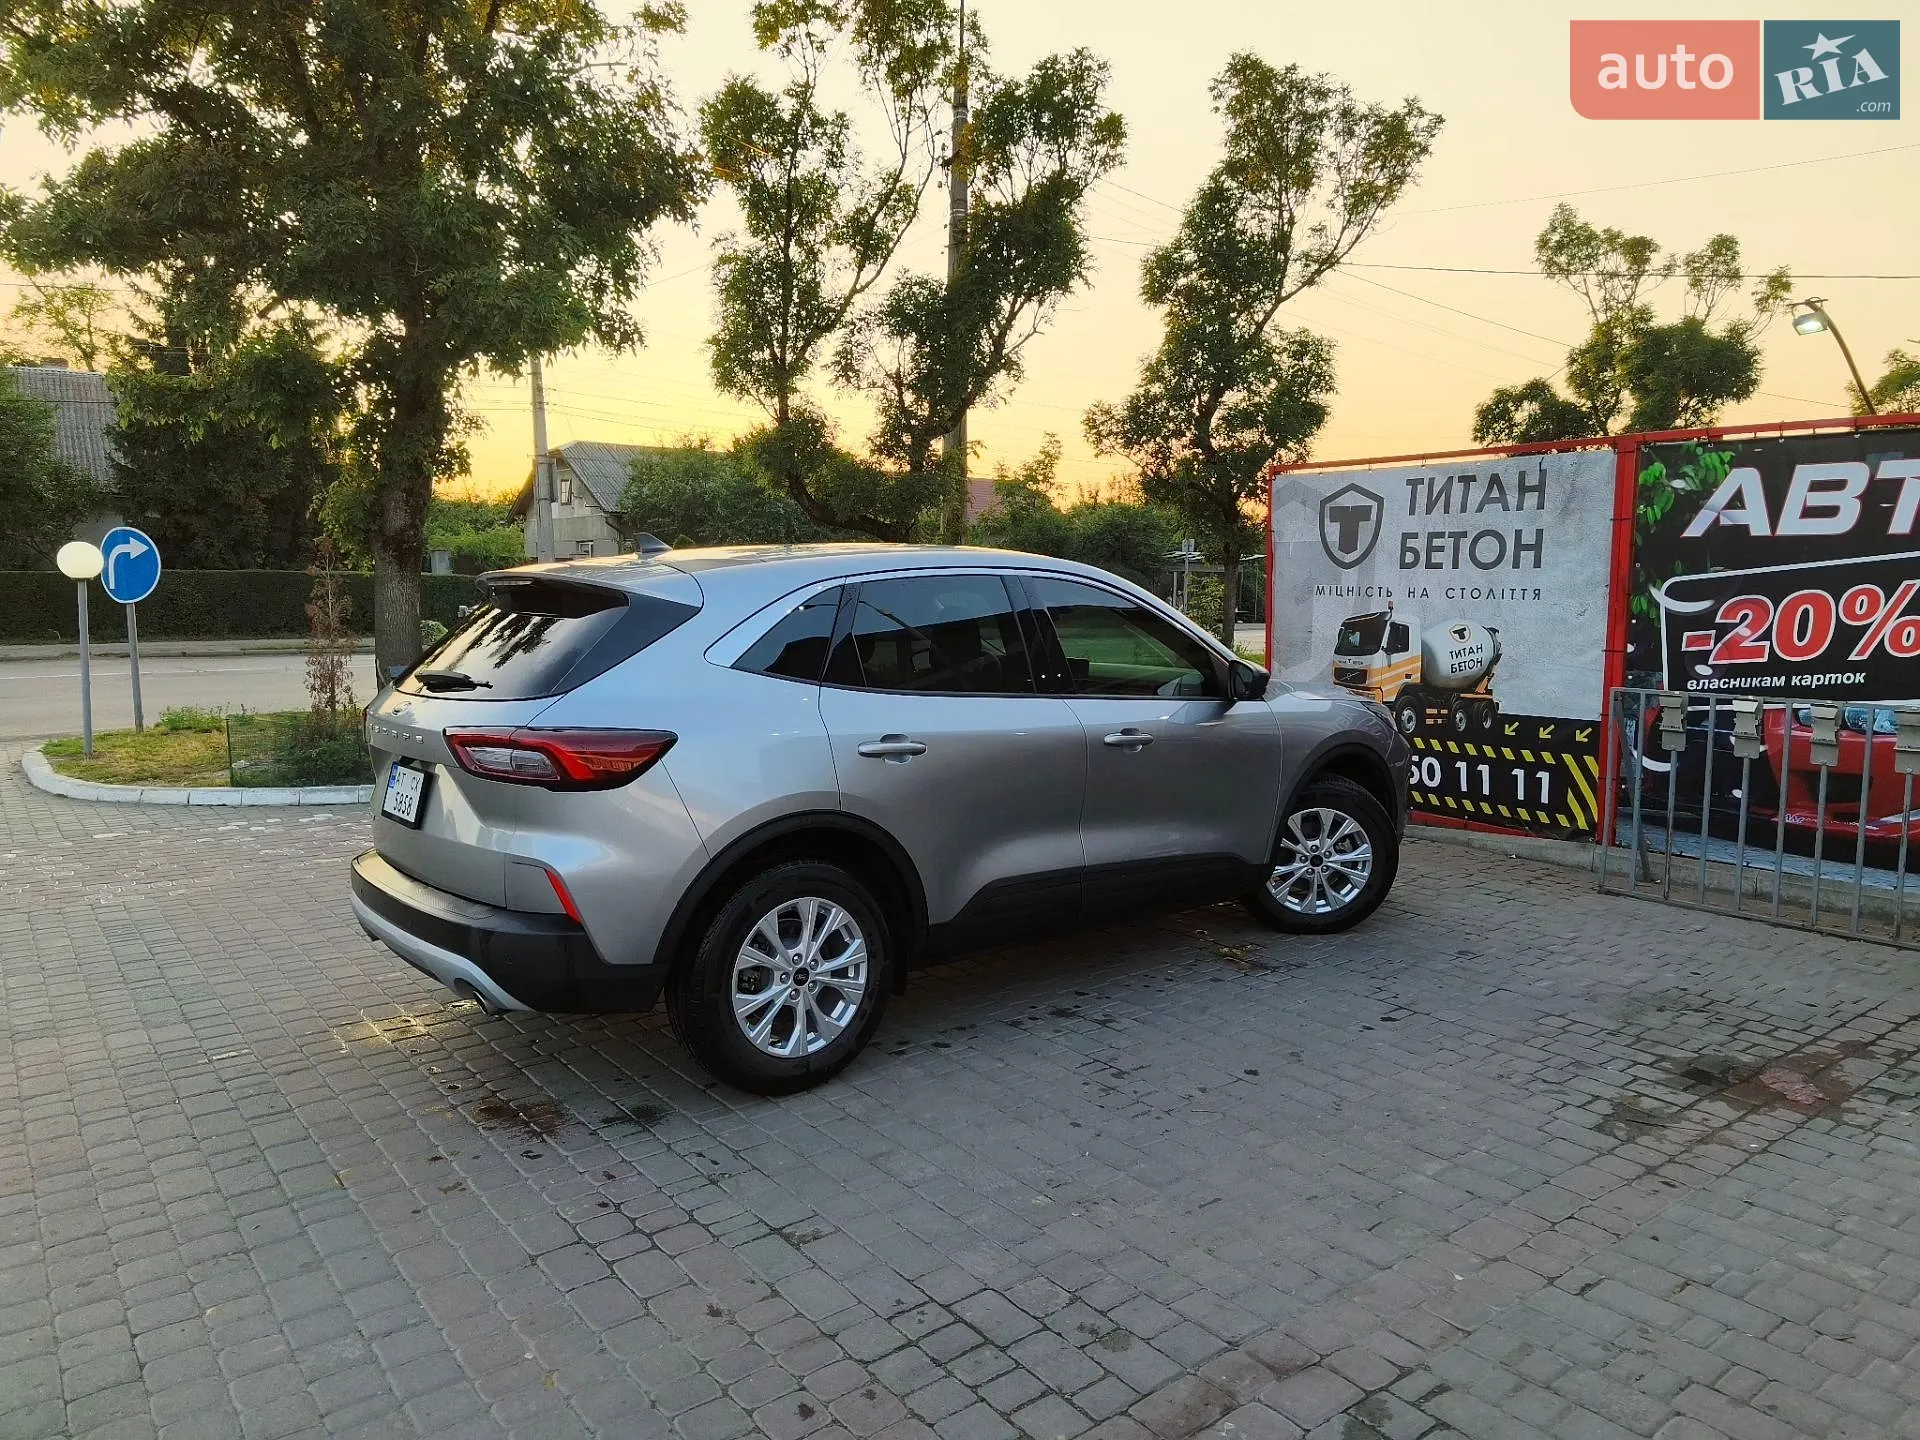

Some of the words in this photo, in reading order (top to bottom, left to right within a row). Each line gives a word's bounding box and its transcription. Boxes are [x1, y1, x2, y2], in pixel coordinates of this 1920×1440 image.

[1405, 468, 1548, 516] ТИТАН
[1399, 528, 1544, 571] БЕТОН
[1315, 584, 1393, 598] МІЦНІСТЬ
[1407, 587, 1430, 599] НА
[1445, 587, 1541, 600] СТОЛІТТЯ
[1681, 579, 1920, 665] -20%
[1449, 643, 1483, 660] ТИТАН
[1450, 657, 1483, 674] БЕТОН
[1686, 674, 1785, 691] власникам
[1791, 671, 1866, 689] карток
[1455, 761, 1490, 796] 11
[1511, 768, 1550, 804] 11
